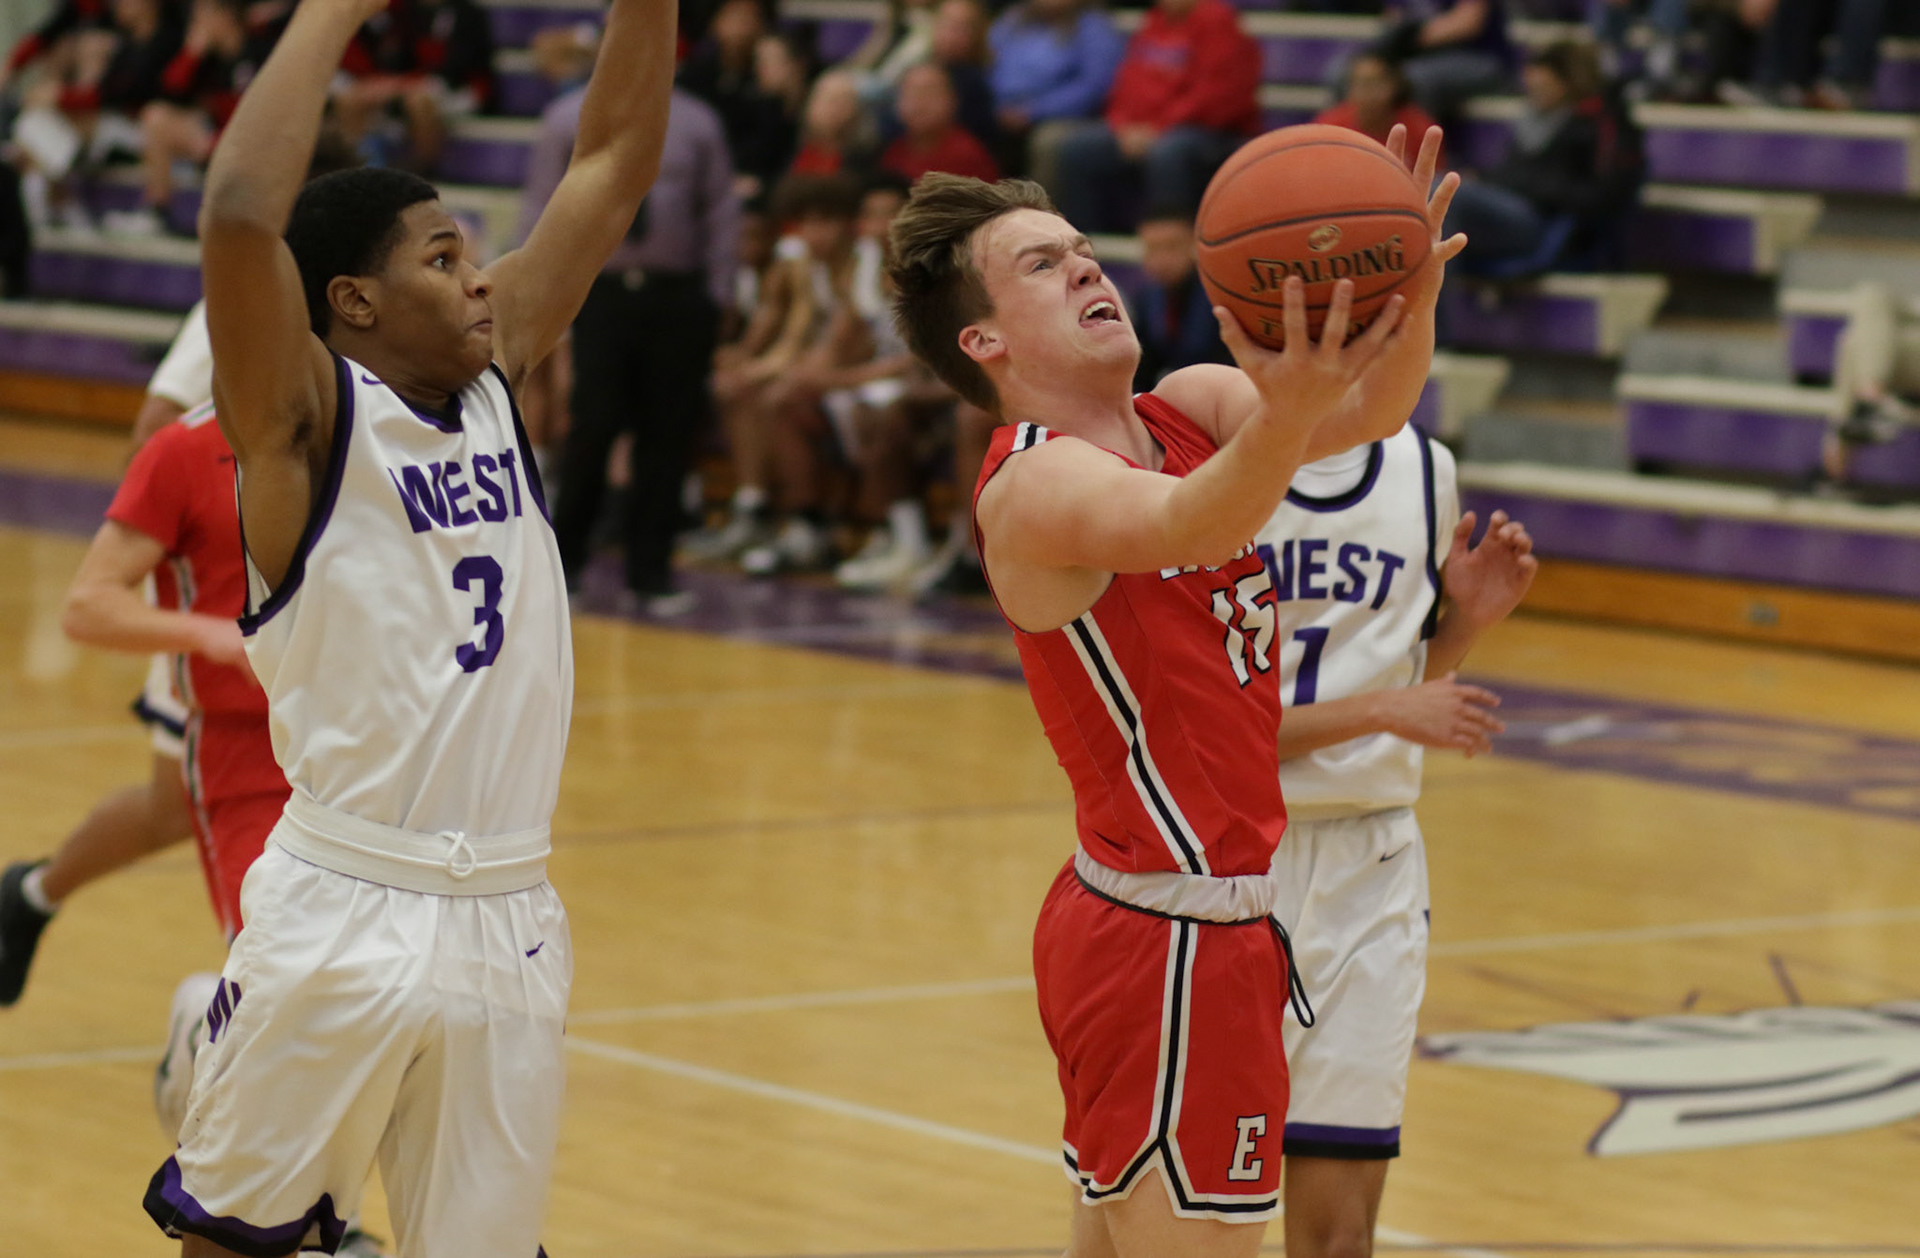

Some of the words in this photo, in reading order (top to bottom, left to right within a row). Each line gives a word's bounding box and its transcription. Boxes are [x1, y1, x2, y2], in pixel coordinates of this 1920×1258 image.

[1247, 235, 1404, 293] SPALDING
[386, 448, 522, 533] WEST
[452, 555, 504, 673] 3
[1210, 568, 1274, 689] 15
[1227, 1114, 1267, 1182] E
